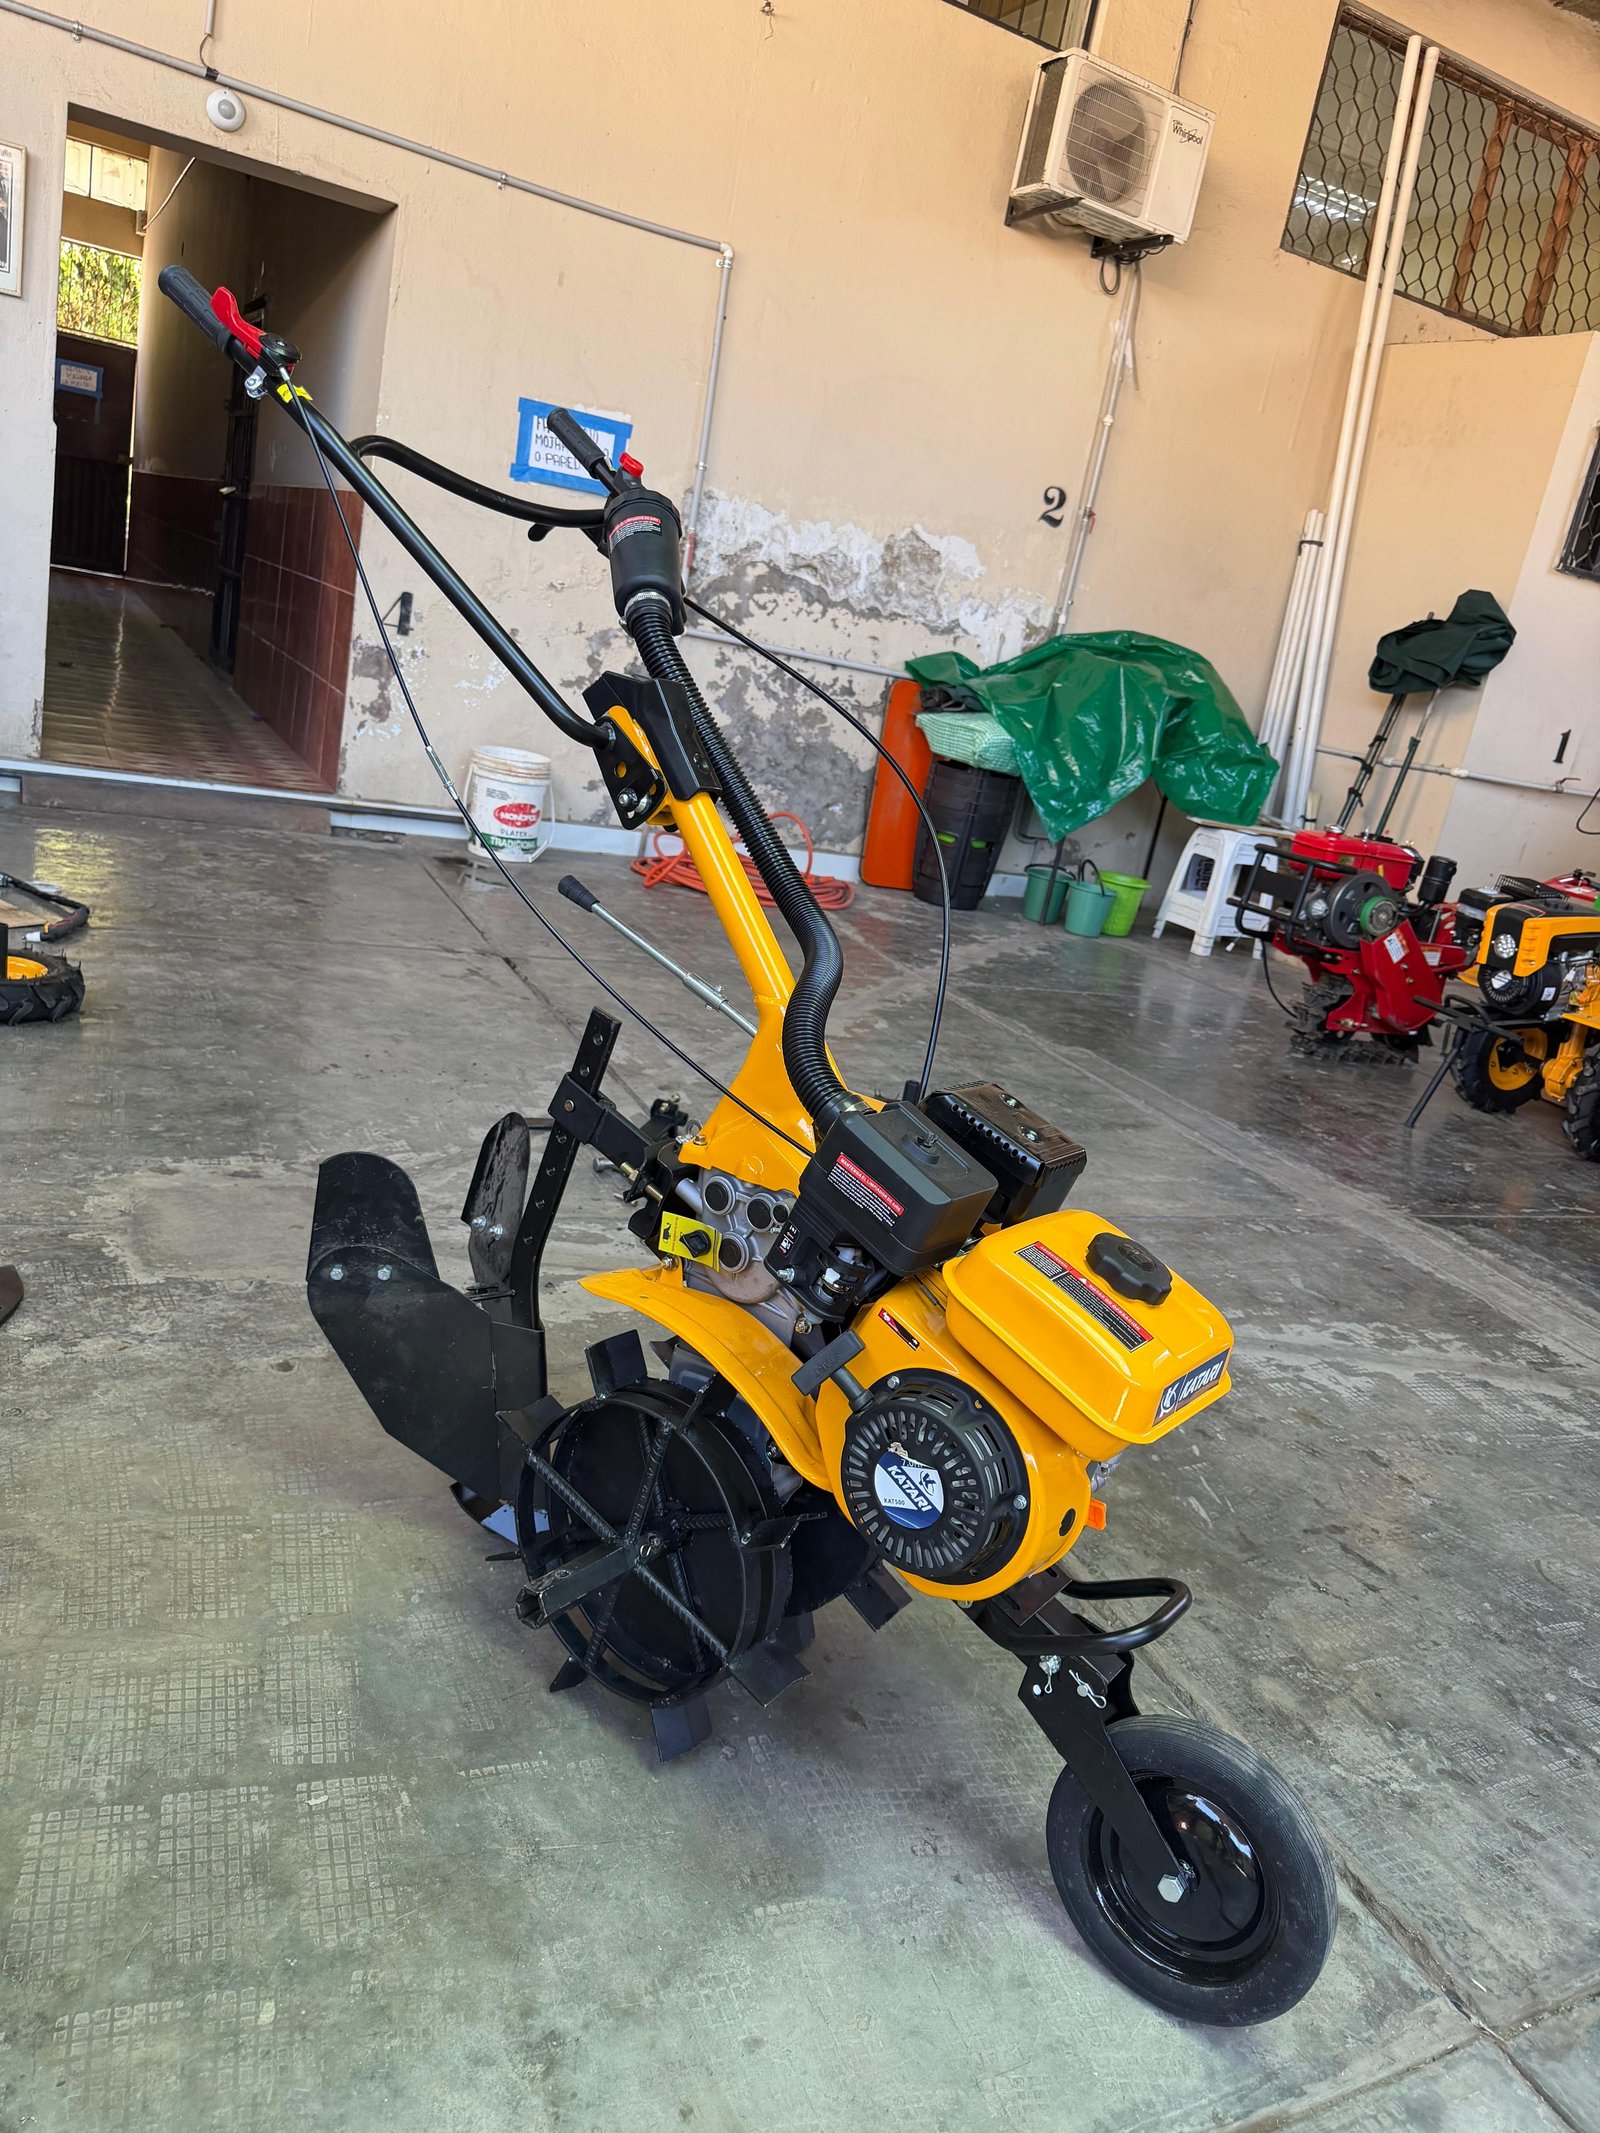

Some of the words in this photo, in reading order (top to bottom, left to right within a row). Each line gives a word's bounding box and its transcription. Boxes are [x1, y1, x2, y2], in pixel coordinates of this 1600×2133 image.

[1172, 122, 1203, 145] Whirlpool
[545, 453, 581, 470] PARED
[1037, 486, 1067, 528] 2
[1552, 728, 1572, 764] 1
[1179, 1360, 1224, 1402] KATARI
[887, 1465, 933, 1512] KATARI
